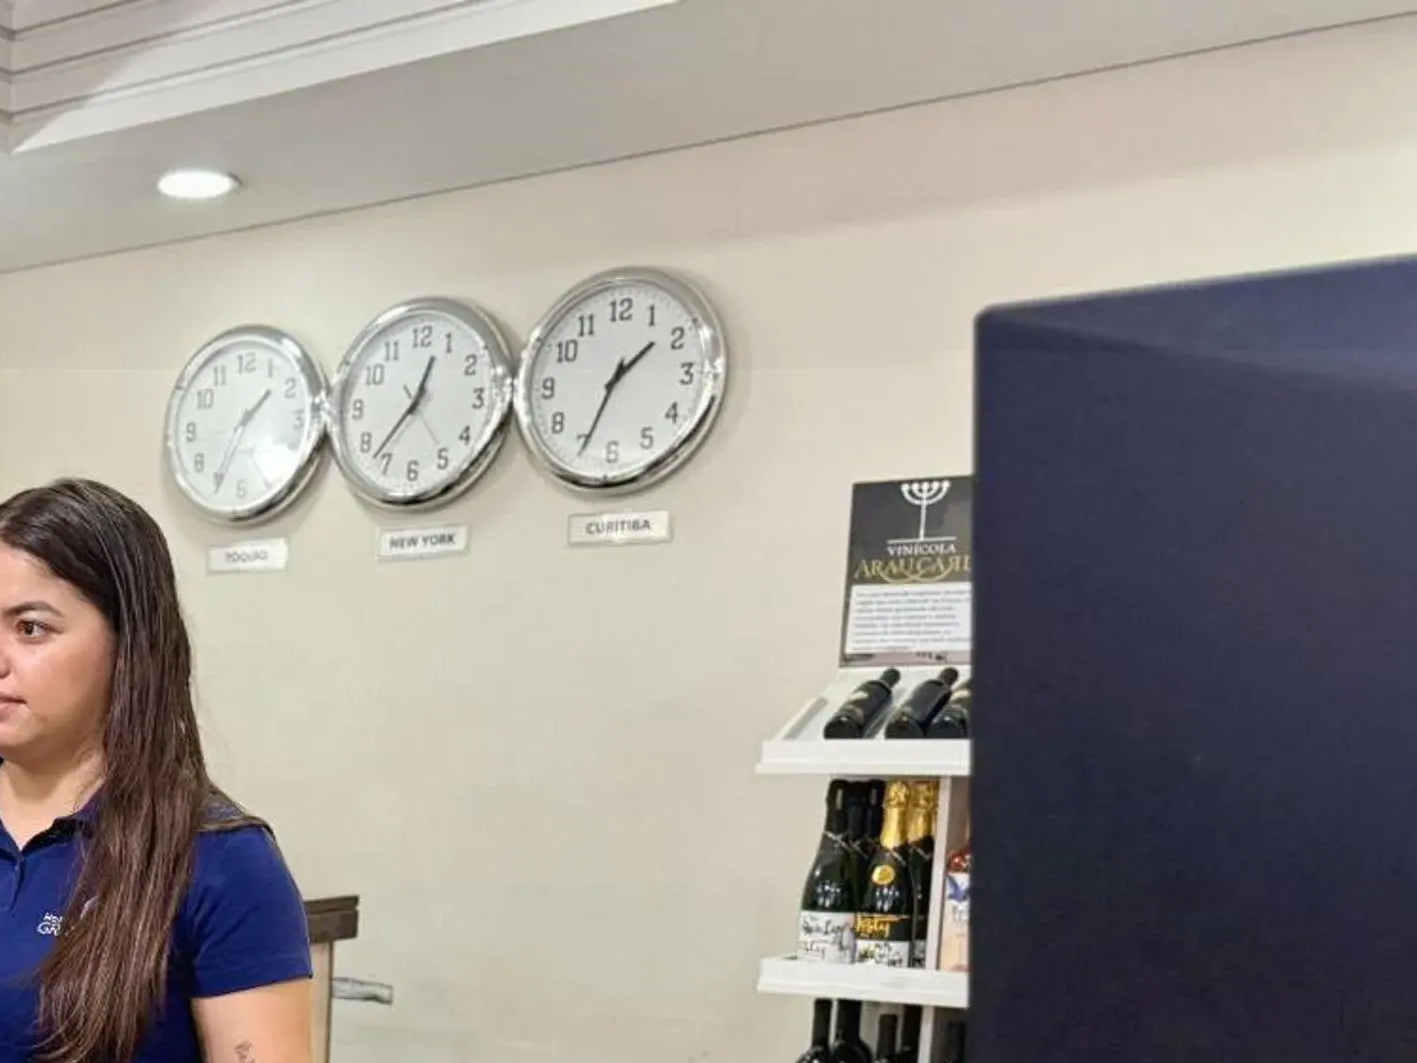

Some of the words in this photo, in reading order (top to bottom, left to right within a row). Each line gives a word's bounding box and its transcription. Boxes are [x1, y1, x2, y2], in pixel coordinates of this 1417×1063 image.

[610, 297, 633, 323] 12
[648, 304, 656, 327] 1
[578, 313, 595, 337] 11
[412, 325, 432, 349] 12
[444, 332, 452, 353] 1
[670, 326, 685, 350] 2
[384, 341, 399, 362] 11
[556, 339, 578, 364] 10
[237, 352, 257, 374] 12
[268, 359, 274, 379] 1
[464, 354, 478, 376] 2
[679, 362, 695, 385] 3
[213, 365, 227, 386] 11
[365, 363, 384, 386] 10
[196, 388, 214, 410] 10
[284, 377, 297, 399] 2
[472, 387, 484, 409] 3
[542, 376, 555, 400] 9
[292, 408, 305, 430] 3
[352, 399, 364, 420] 9
[665, 401, 679, 424] 4
[186, 422, 196, 442] 9
[551, 411, 565, 434] 8
[360, 432, 372, 453] 8
[458, 425, 471, 446] 4
[640, 426, 654, 450] 5
[194, 453, 205, 473] 8
[437, 448, 449, 470] 5
[605, 440, 620, 464] 6
[382, 453, 393, 475] 7
[407, 460, 419, 482] 6
[236, 479, 246, 499] 6
[585, 518, 651, 535] CURITIBA
[389, 536, 418, 549] NEW
[422, 532, 456, 546] YORK
